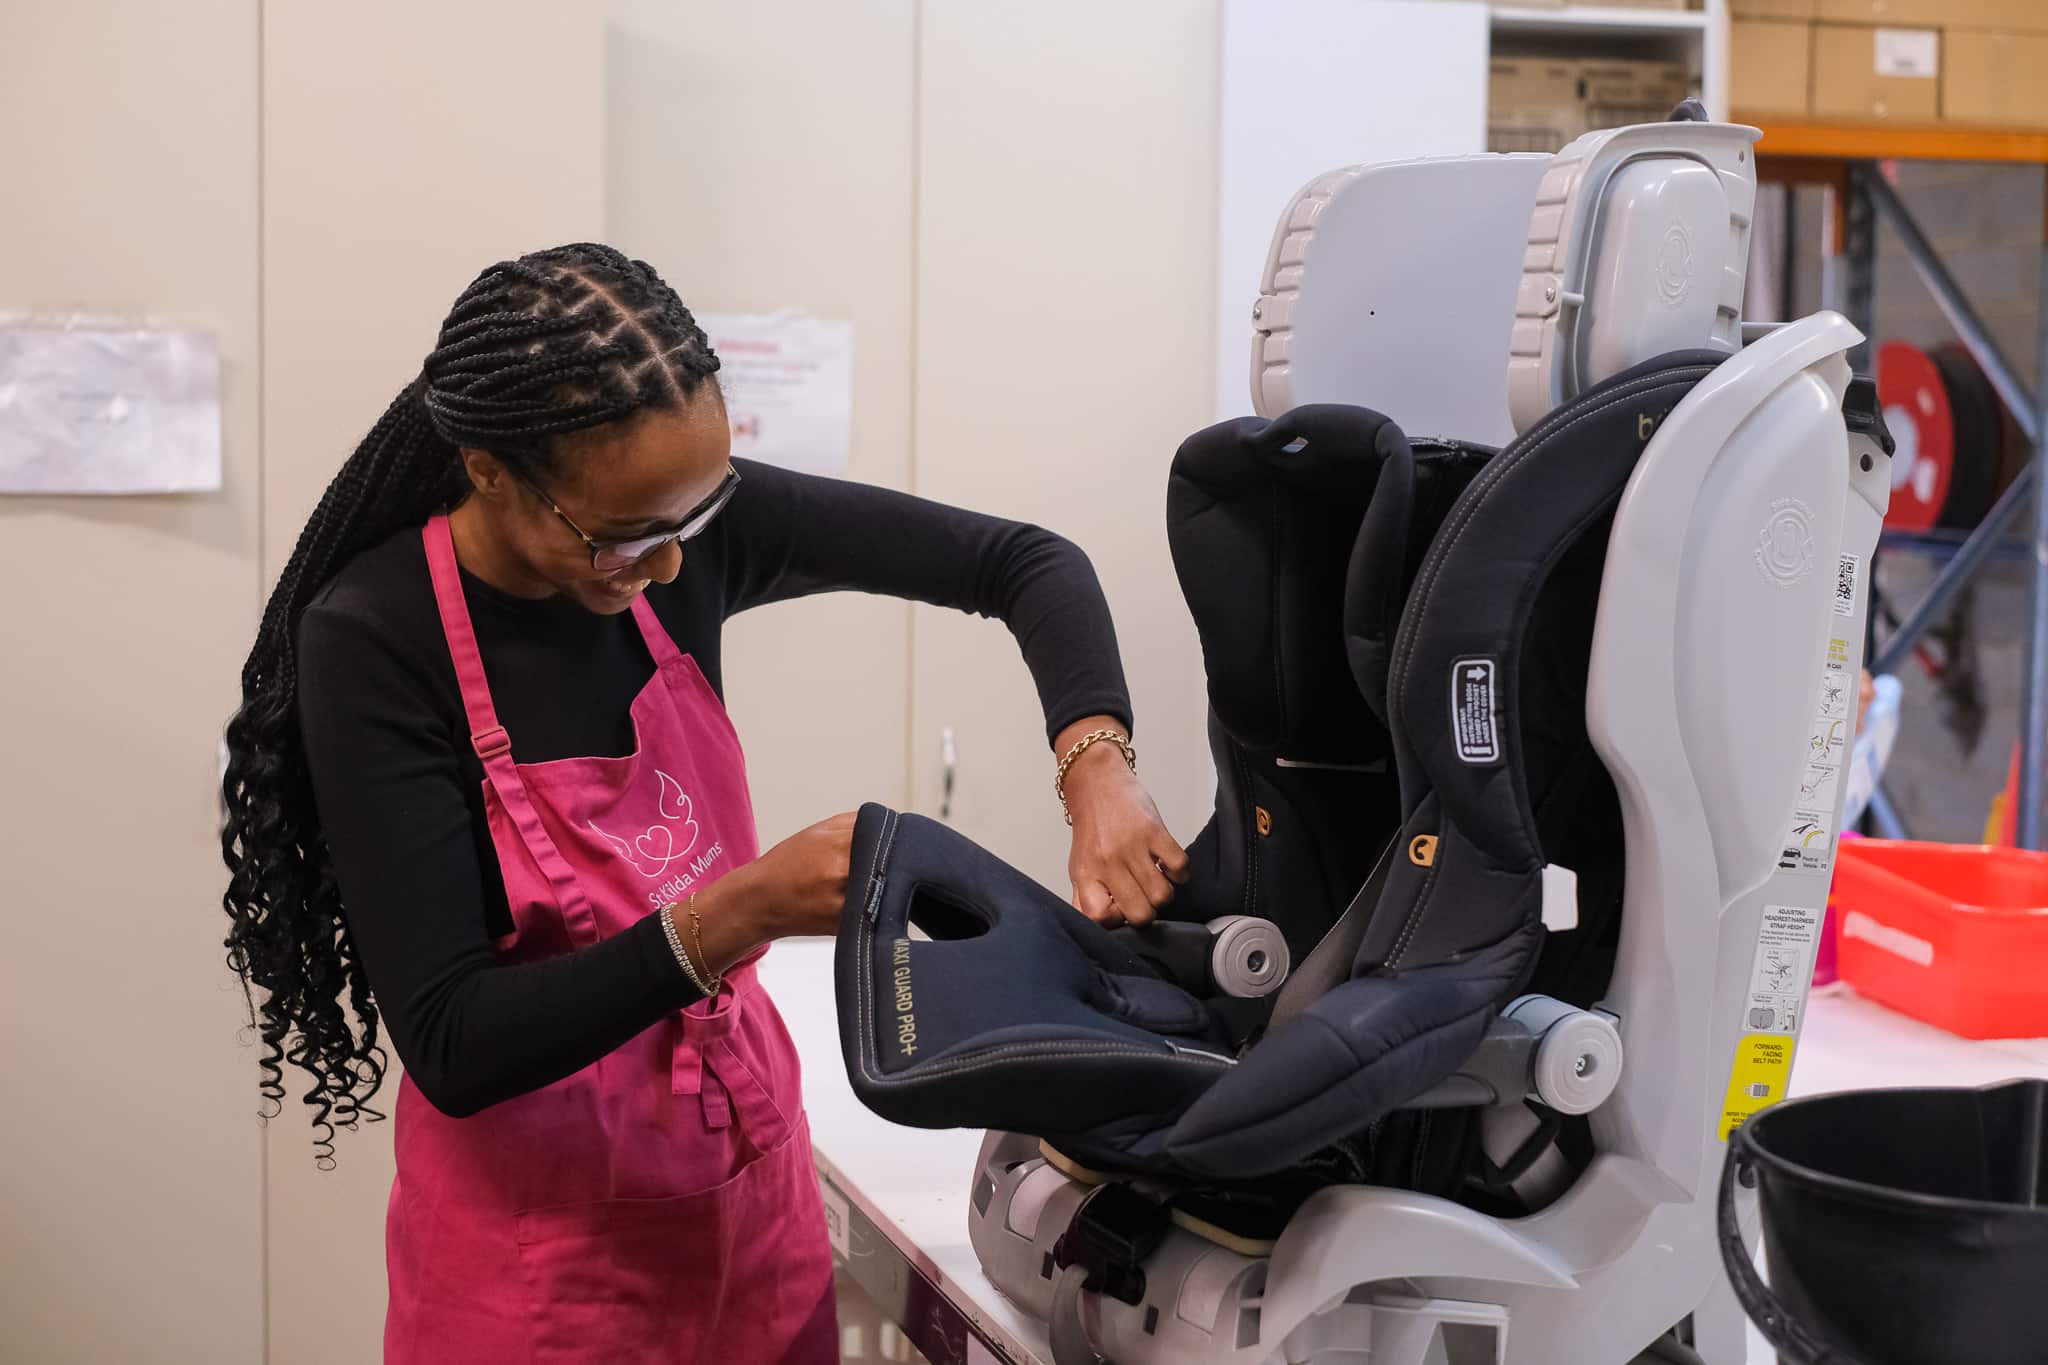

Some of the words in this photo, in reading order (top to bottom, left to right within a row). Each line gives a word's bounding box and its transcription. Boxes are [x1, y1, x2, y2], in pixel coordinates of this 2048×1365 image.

[1472, 683, 1480, 710] POCKET
[1480, 684, 1488, 707] COVER
[1467, 703, 1476, 744] INSTRUCTION
[1473, 709, 1480, 718] IN
[1474, 718, 1483, 744] STORED
[1481, 721, 1491, 744] UNDER
[649, 892, 667, 910] St
[659, 873, 695, 900] Kilda
[689, 842, 722, 877] Mums
[1778, 908, 1806, 916] ADJUSTING
[894, 938, 911, 966] MAXI
[894, 966, 913, 1012] GUARD
[897, 1013, 918, 1056] PRO+
[1762, 1050, 1783, 1058] FACING
